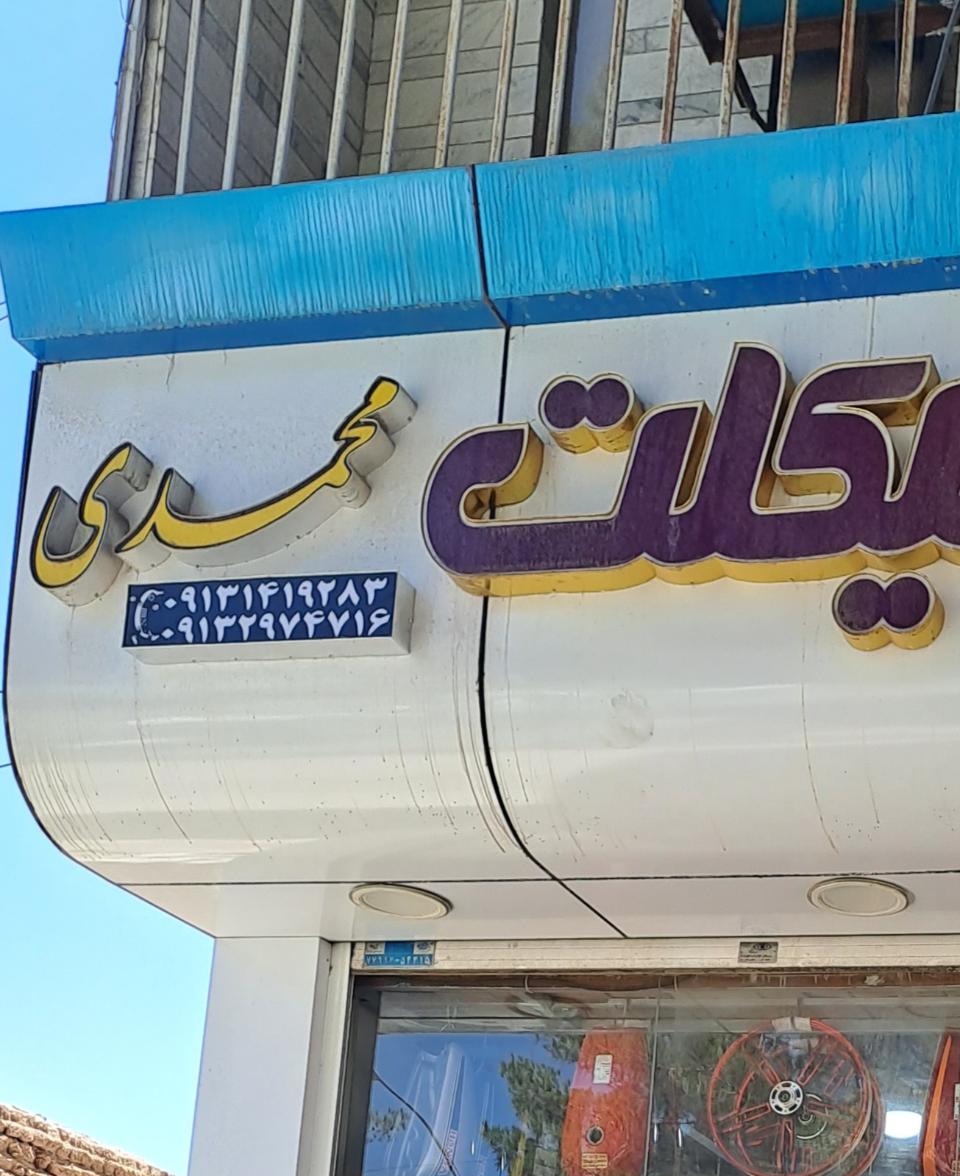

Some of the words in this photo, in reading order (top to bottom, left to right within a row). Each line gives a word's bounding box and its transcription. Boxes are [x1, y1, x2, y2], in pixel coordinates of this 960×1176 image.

[30, 375, 412, 602] محمدی
[164, 576, 388, 614] ۰۹۱۳۱۴۱۹۲۸۳
[161, 607, 391, 643] ۰۹۱۳۲۹۷۴۷۱۶
